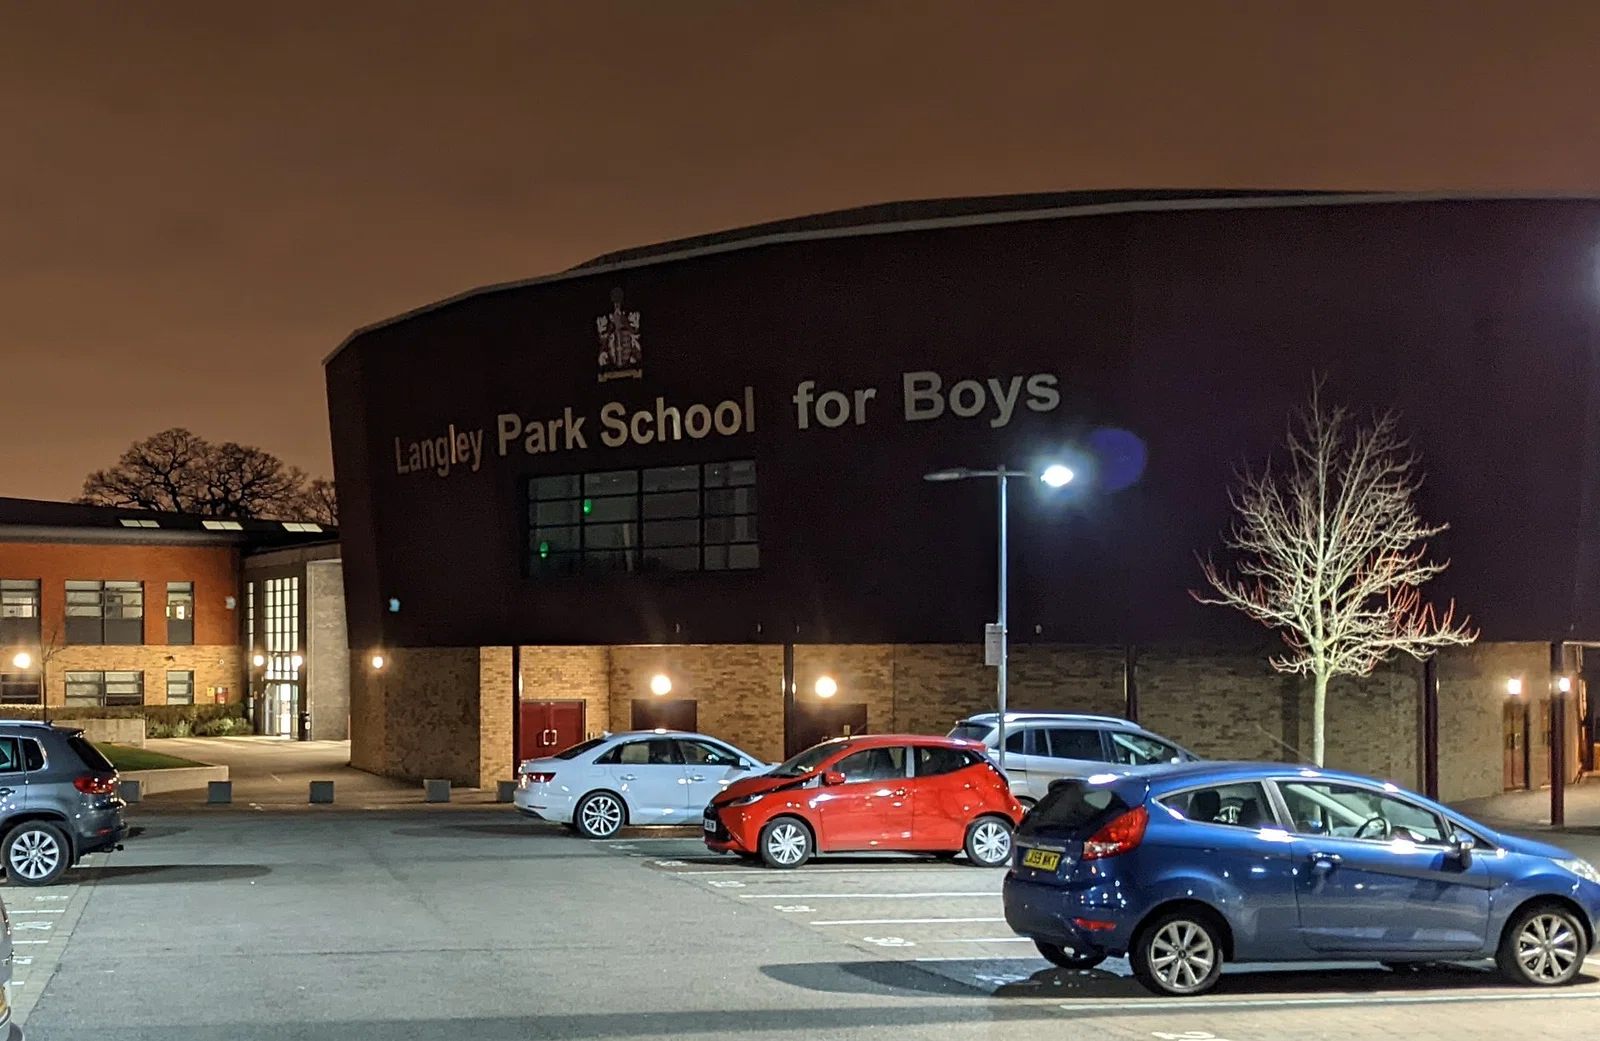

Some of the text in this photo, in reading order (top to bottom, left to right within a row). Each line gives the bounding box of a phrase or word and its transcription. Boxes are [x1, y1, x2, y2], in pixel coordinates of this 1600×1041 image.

[395, 371, 1061, 478] Langley Park School for Boys
